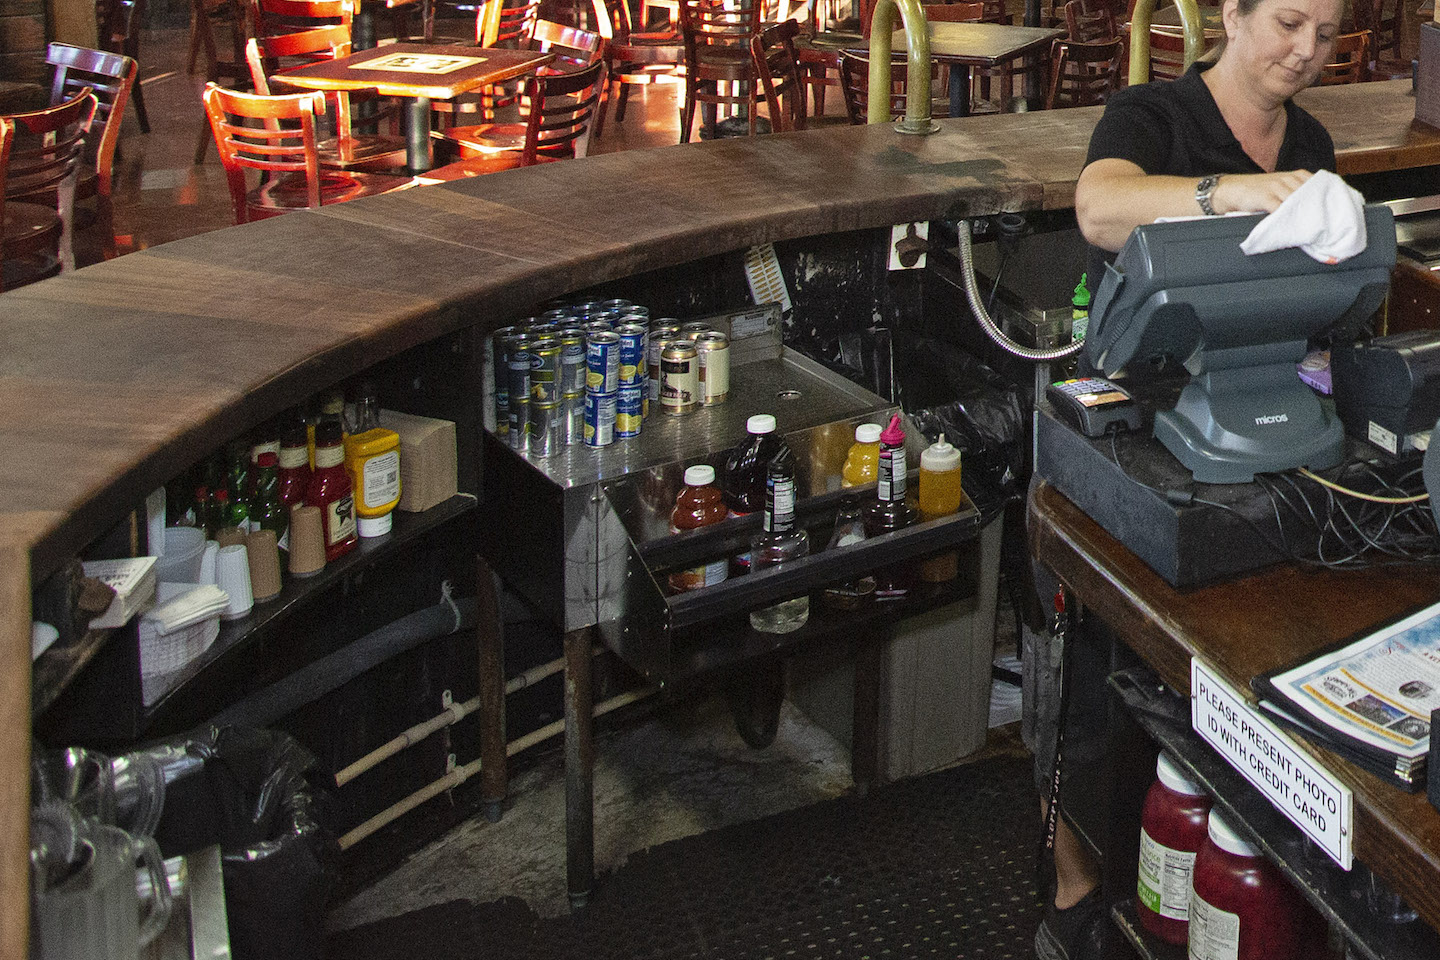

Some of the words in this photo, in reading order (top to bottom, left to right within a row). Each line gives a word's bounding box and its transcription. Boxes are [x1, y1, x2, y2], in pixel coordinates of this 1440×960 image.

[1254, 413, 1289, 426] micros
[1199, 682, 1239, 729] PLEASE
[1241, 720, 1293, 776] PRESENT
[1295, 767, 1337, 816] PHOTO
[1207, 713, 1219, 735] ID
[1219, 724, 1248, 762] WITH
[1249, 752, 1291, 800] CREDIT
[1293, 792, 1327, 834] CARD
